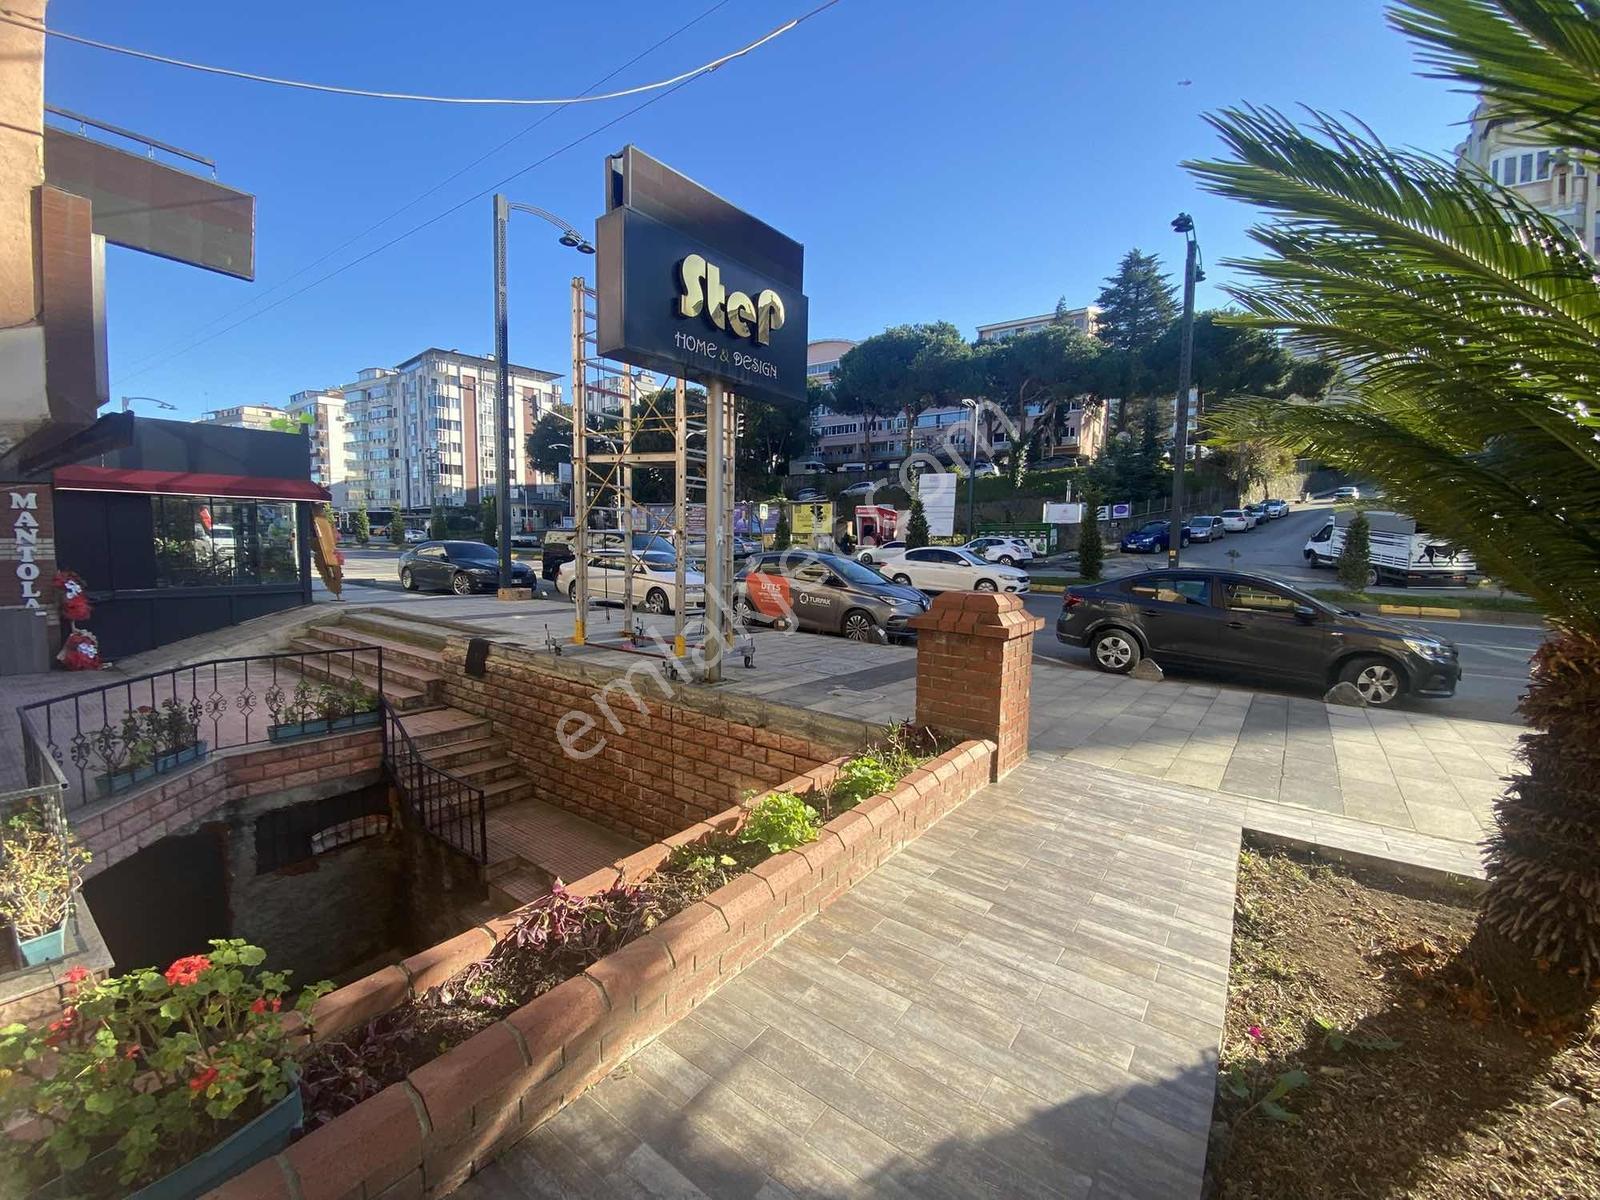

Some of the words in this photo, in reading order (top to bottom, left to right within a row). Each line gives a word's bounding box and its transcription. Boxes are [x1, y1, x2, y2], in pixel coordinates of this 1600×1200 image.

[680, 253, 786, 347] Step
[674, 331, 718, 359] HOME
[719, 349, 730, 364] &
[732, 351, 778, 380] DESIGN
